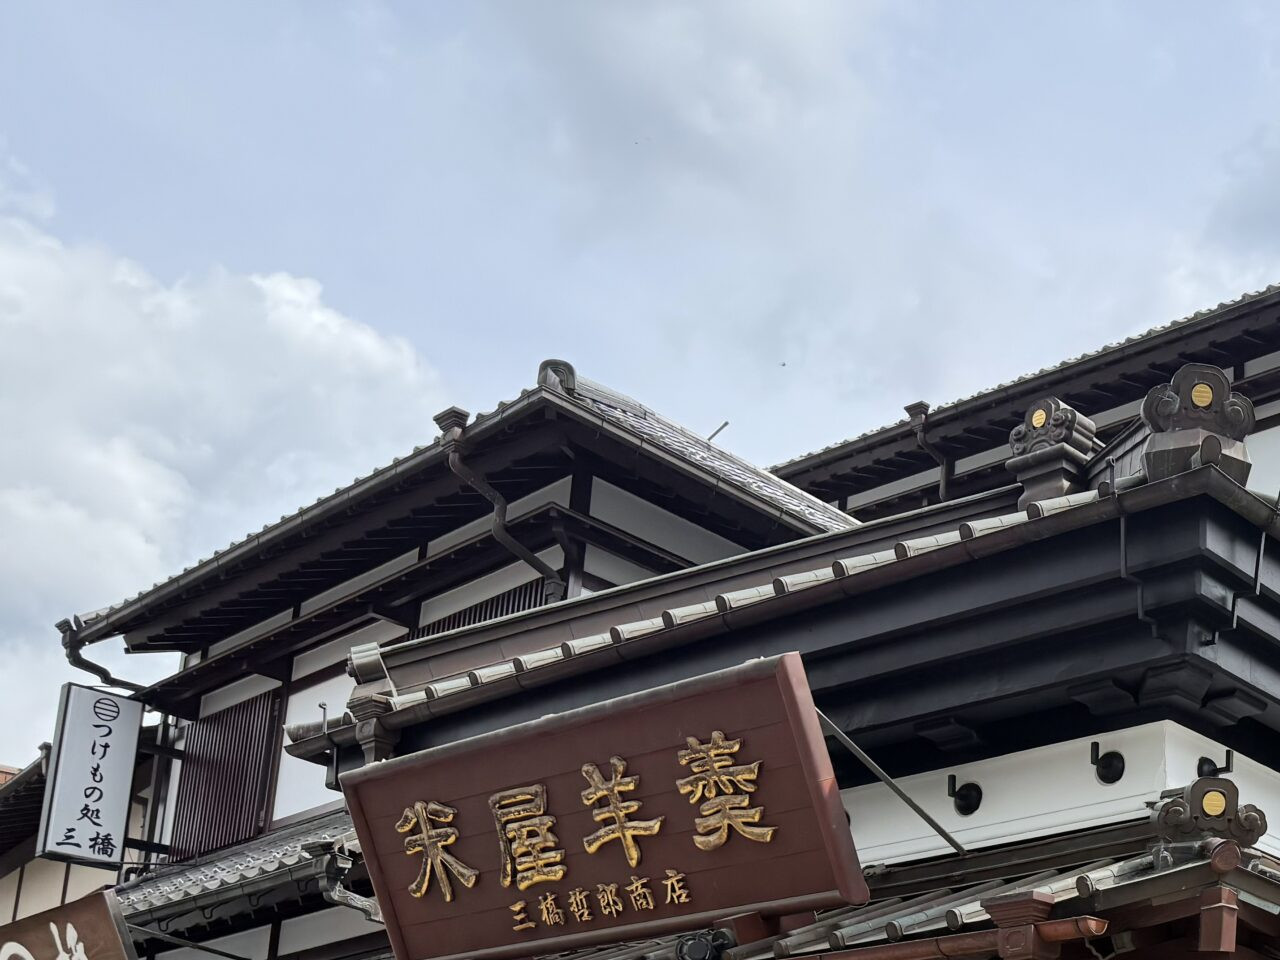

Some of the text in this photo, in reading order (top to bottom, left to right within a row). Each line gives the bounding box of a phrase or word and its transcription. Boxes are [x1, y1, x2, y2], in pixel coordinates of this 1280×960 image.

[76, 723, 113, 827] つけもの処
[395, 730, 778, 904] 米屋羊羹
[55, 827, 117, 858] 三橋
